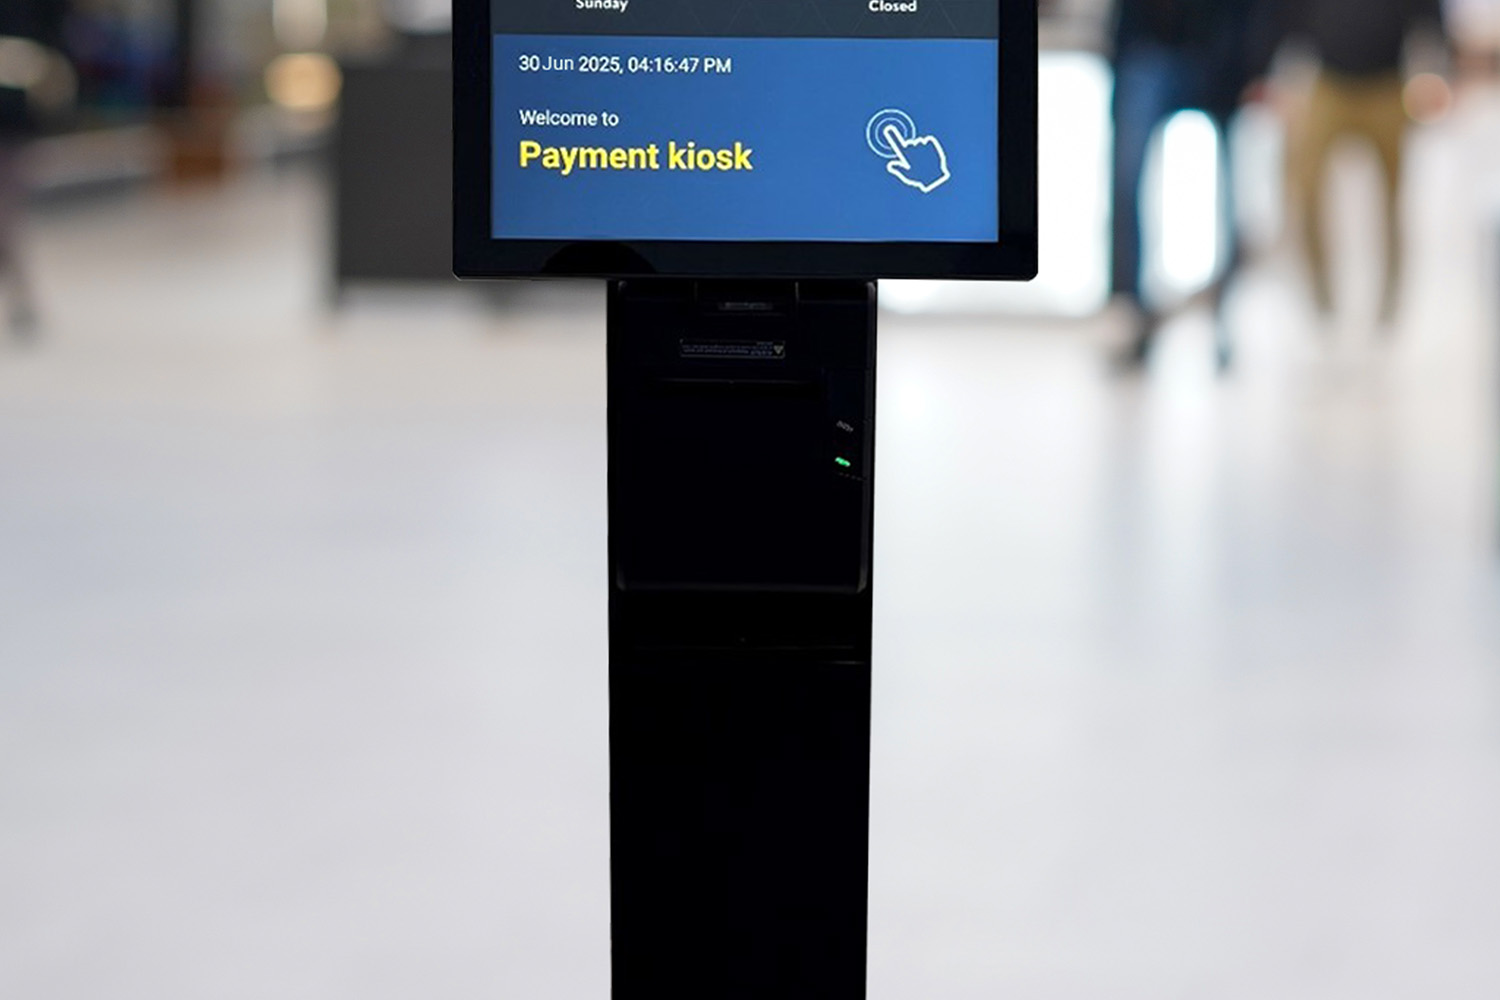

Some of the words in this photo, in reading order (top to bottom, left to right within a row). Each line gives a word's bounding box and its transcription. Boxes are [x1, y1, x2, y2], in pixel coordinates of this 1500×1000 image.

[868, 0, 918, 12] Closed
[518, 54, 541, 72] 30
[541, 55, 575, 71] Jun
[578, 55, 624, 75] 2025,
[627, 56, 700, 73] 04:16:47
[703, 57, 732, 73] PM
[519, 109, 598, 127] Welcome
[601, 111, 620, 127] to
[519, 140, 660, 176] Payment
[668, 141, 753, 171] kiosk
